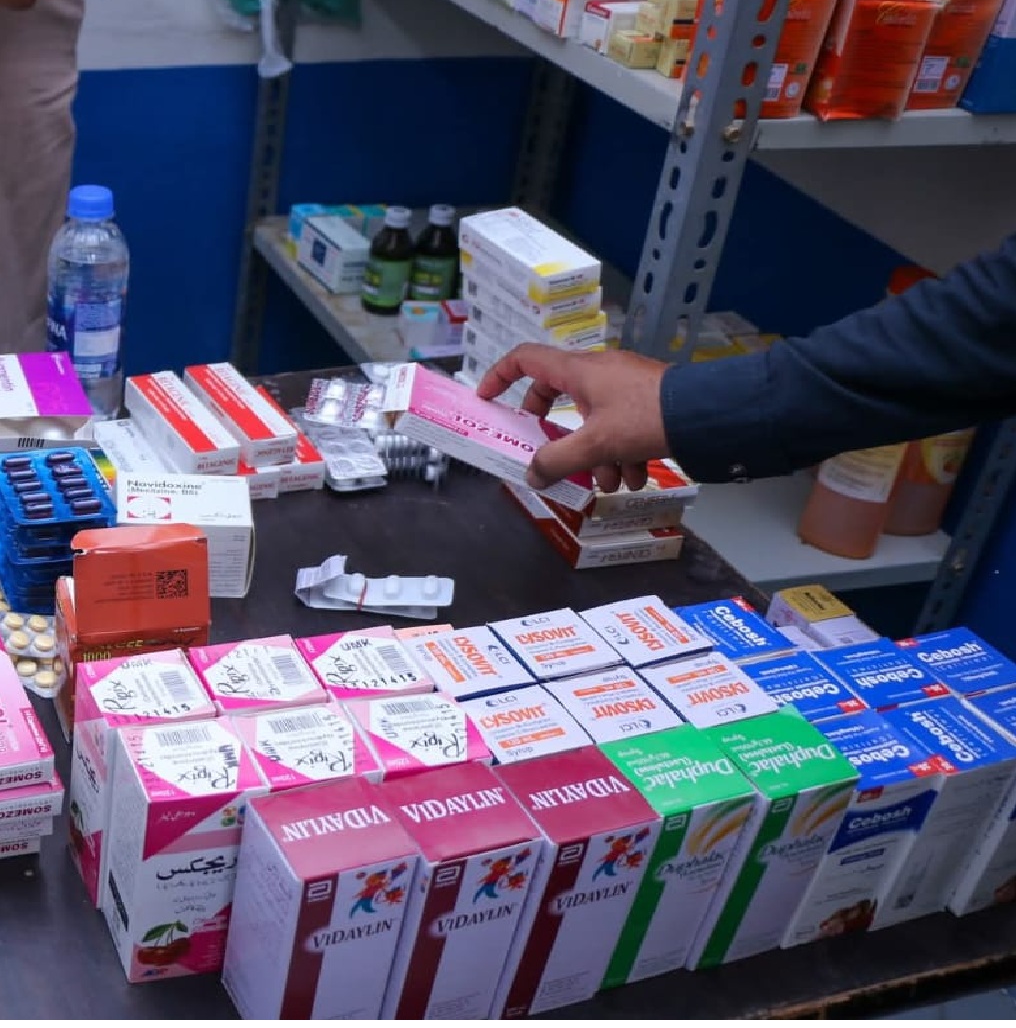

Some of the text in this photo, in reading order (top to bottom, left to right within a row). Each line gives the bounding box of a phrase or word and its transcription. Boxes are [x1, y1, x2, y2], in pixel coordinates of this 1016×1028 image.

[515, 625, 577, 645] LYSOVIT
[714, 605, 768, 647] Cebosh
[917, 641, 982, 663] Cebosh
[854, 665, 925, 687] Cebosh
[687, 680, 751, 706] LYSOVIT
[479, 705, 546, 729] LYSOVIT
[592, 698, 657, 719] LYSOVIT
[910, 711, 974, 763] Cebosh
[747, 742, 836, 777] Duphalac
[643, 756, 734, 790] Duphalac
